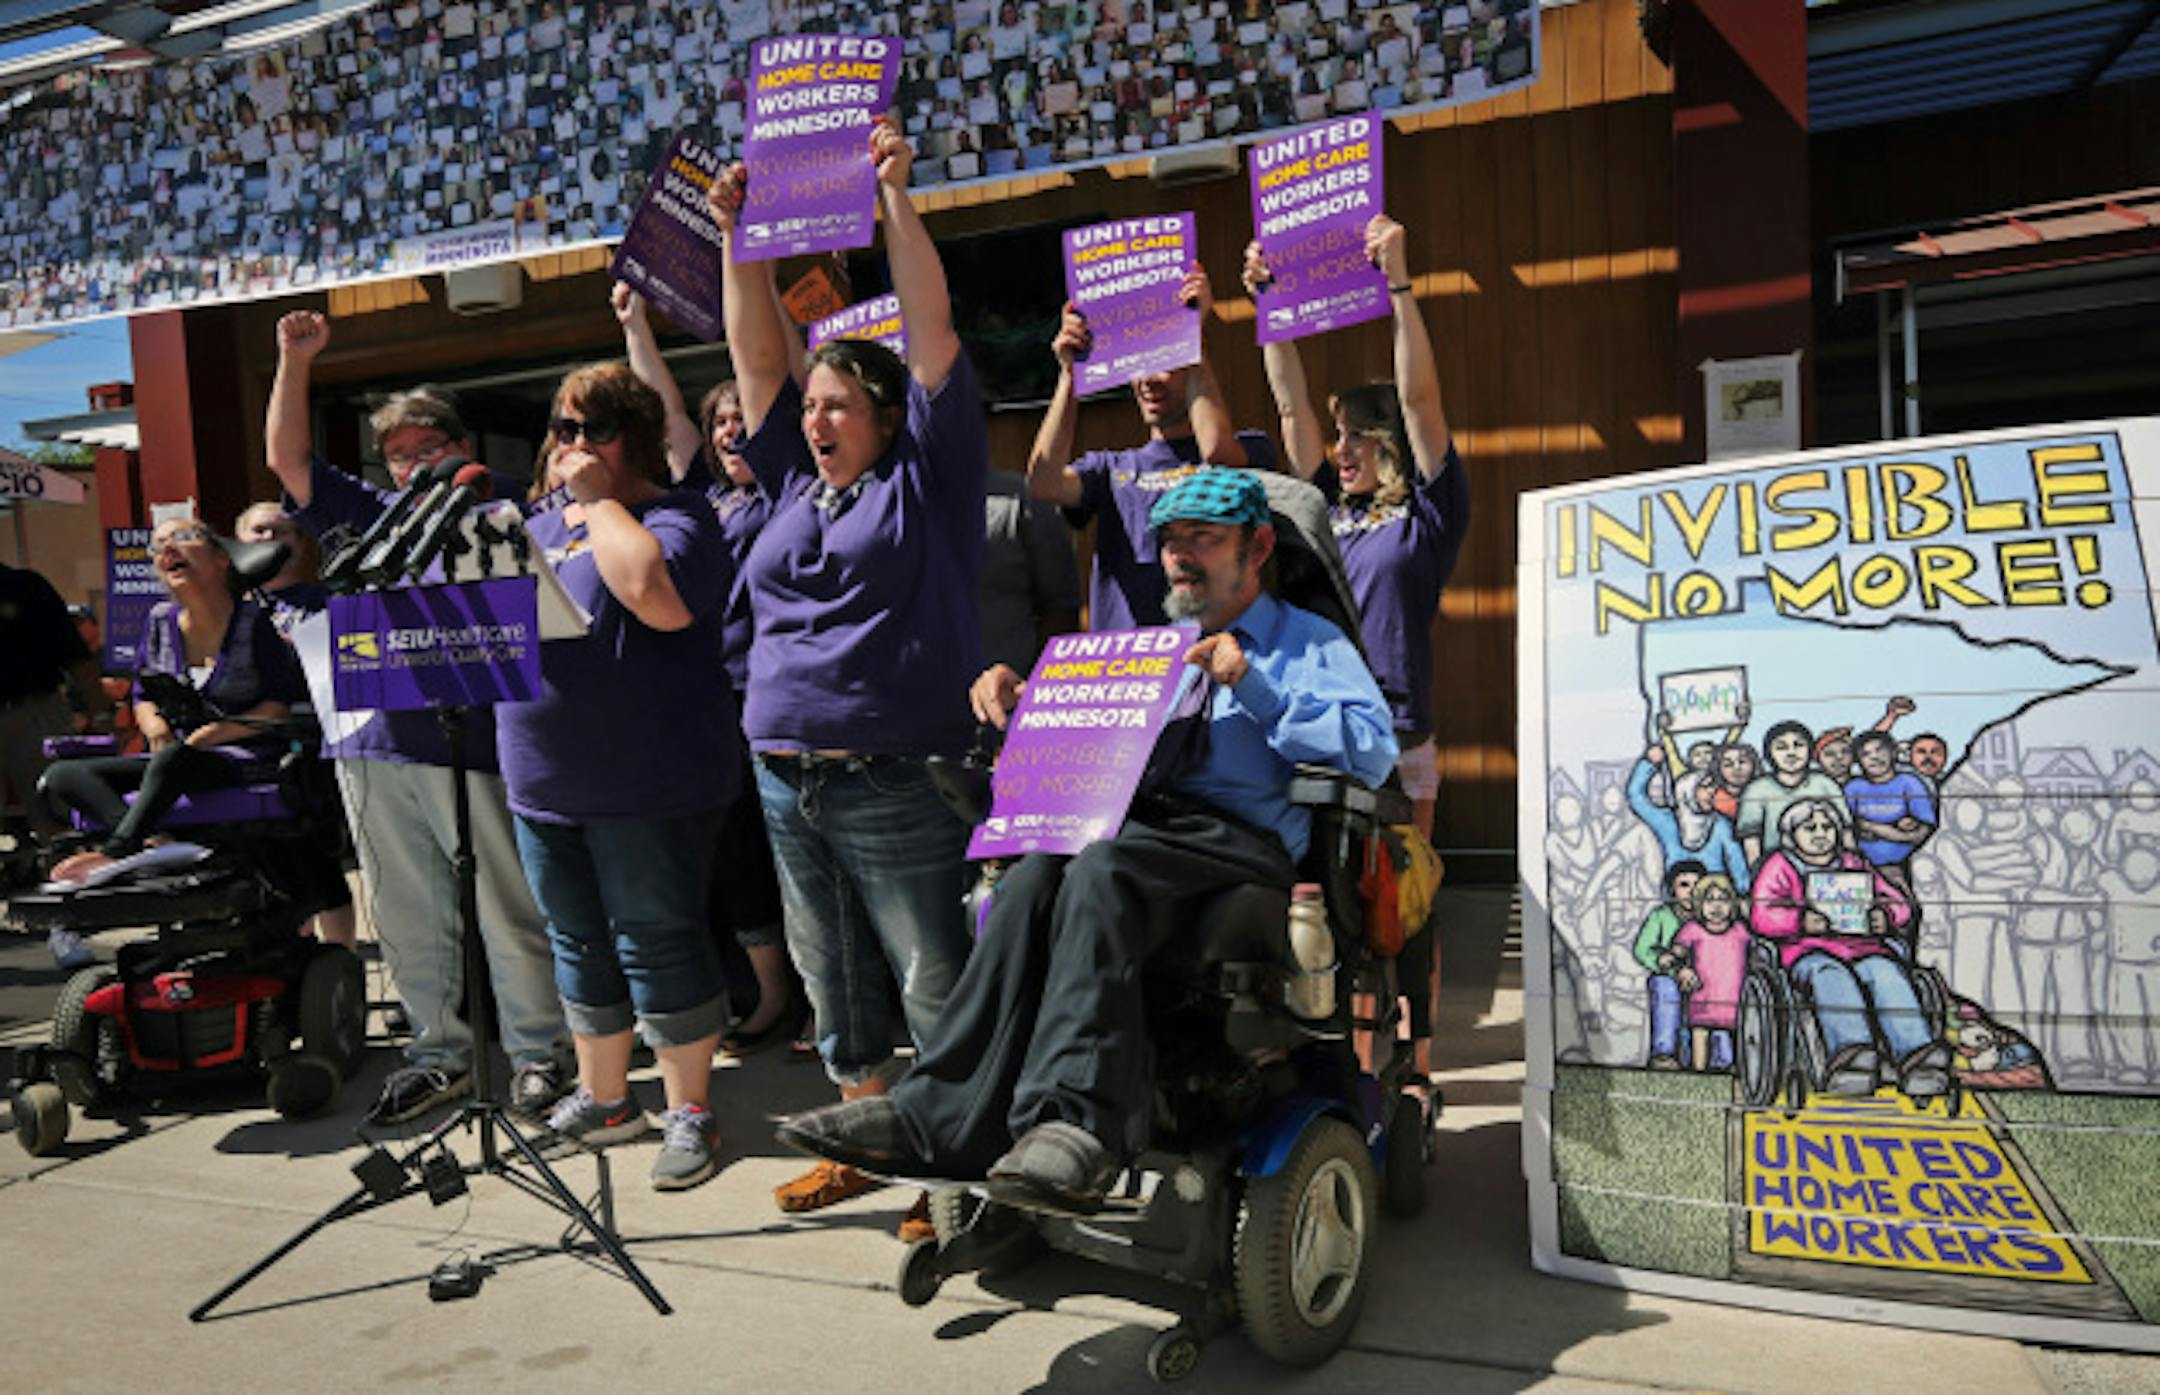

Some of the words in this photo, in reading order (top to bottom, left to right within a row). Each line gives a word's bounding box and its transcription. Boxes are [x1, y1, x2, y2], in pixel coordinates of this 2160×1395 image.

[760, 36, 888, 66] UNITED
[757, 63, 816, 91] HOME
[819, 60, 883, 80] CARE
[756, 83, 880, 116] WORKERS
[751, 107, 872, 141] MINNESOTA
[1256, 118, 1370, 169] UNITED
[1259, 157, 1312, 191] HOME
[1314, 142, 1369, 171] CARE
[1260, 163, 1371, 213] WORKERS
[1261, 189, 1370, 237] MINNESOTA
[1072, 217, 1183, 247] UNITED
[1074, 240, 1128, 264] HOME
[1131, 234, 1184, 251] CARE
[1076, 249, 1185, 283] WORKERS
[1075, 266, 1184, 303] MINNESOTA
[815, 296, 900, 338] UNITED
[1556, 442, 2115, 579] INVISIBLE
[1595, 569, 1727, 635] NO
[1765, 534, 2113, 616] MORE!
[1054, 630, 1181, 658] UNITED
[1041, 660, 1106, 680] HOME
[1107, 657, 1173, 677] CARE
[1032, 681, 1162, 705] WORKERS
[1018, 708, 1148, 731] MINNESOTA
[1755, 1130, 2003, 1180] UNITED
[1755, 1175, 1900, 1214] HOME
[1908, 1181, 2037, 1221] CARE
[1764, 1210, 2065, 1273] WORKERS
